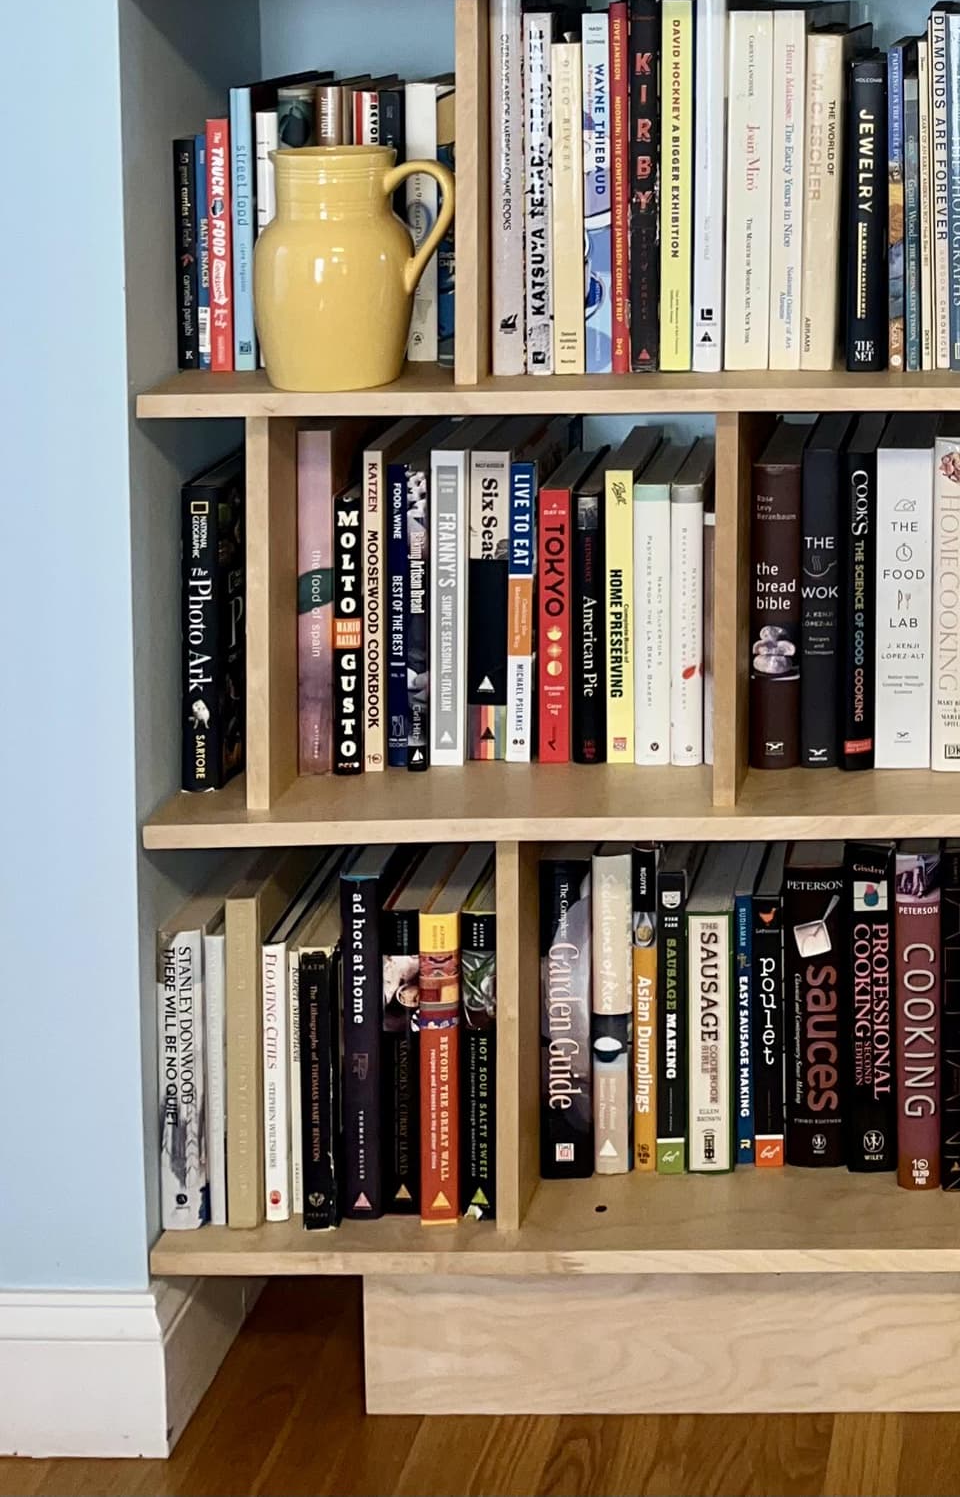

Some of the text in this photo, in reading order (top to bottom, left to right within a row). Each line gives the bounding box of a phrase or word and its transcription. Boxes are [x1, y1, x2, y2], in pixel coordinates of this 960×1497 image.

[671, 19, 680, 258] DAVID HOCKNEY A BIGGER EXHIBITION
[858, 109, 874, 214] JEWELRY
[933, 16, 948, 241] DIAMONDS ARE FOREVER
[212, 147, 225, 256] TRUCK FOOD
[237, 145, 249, 226] street food
[438, 513, 455, 588] FRANNY'S
[514, 474, 530, 566] LIVE TO EAT
[544, 524, 564, 617] TOKYO
[756, 562, 778, 575] the
[883, 570, 925, 580] FOOD
[891, 521, 919, 532] THE
[189, 579, 212, 693] Photo Ark
[368, 463, 379, 728] KATZEN MOOSEWOOD COOKBOOK
[610, 569, 624, 698] HOME PRESERVING
[756, 579, 796, 592] bread
[756, 596, 792, 610] bible
[889, 618, 919, 628] LAB
[582, 596, 597, 697] American Pie
[265, 953, 279, 1070] FLOATING CITIES
[352, 893, 366, 1024] ad hoc at home
[700, 932, 718, 1041] SAUSAGE
[854, 923, 871, 1037] COOKING
[871, 923, 890, 1100] PROFESSIONAL
[178, 946, 194, 1105] STANLEY DONWOOD
[547, 943, 582, 1109] Garden Guide
[634, 976, 653, 1113] Asian Dumplings
[806, 965, 838, 1112] sauces
[903, 943, 935, 1117] COOKING
